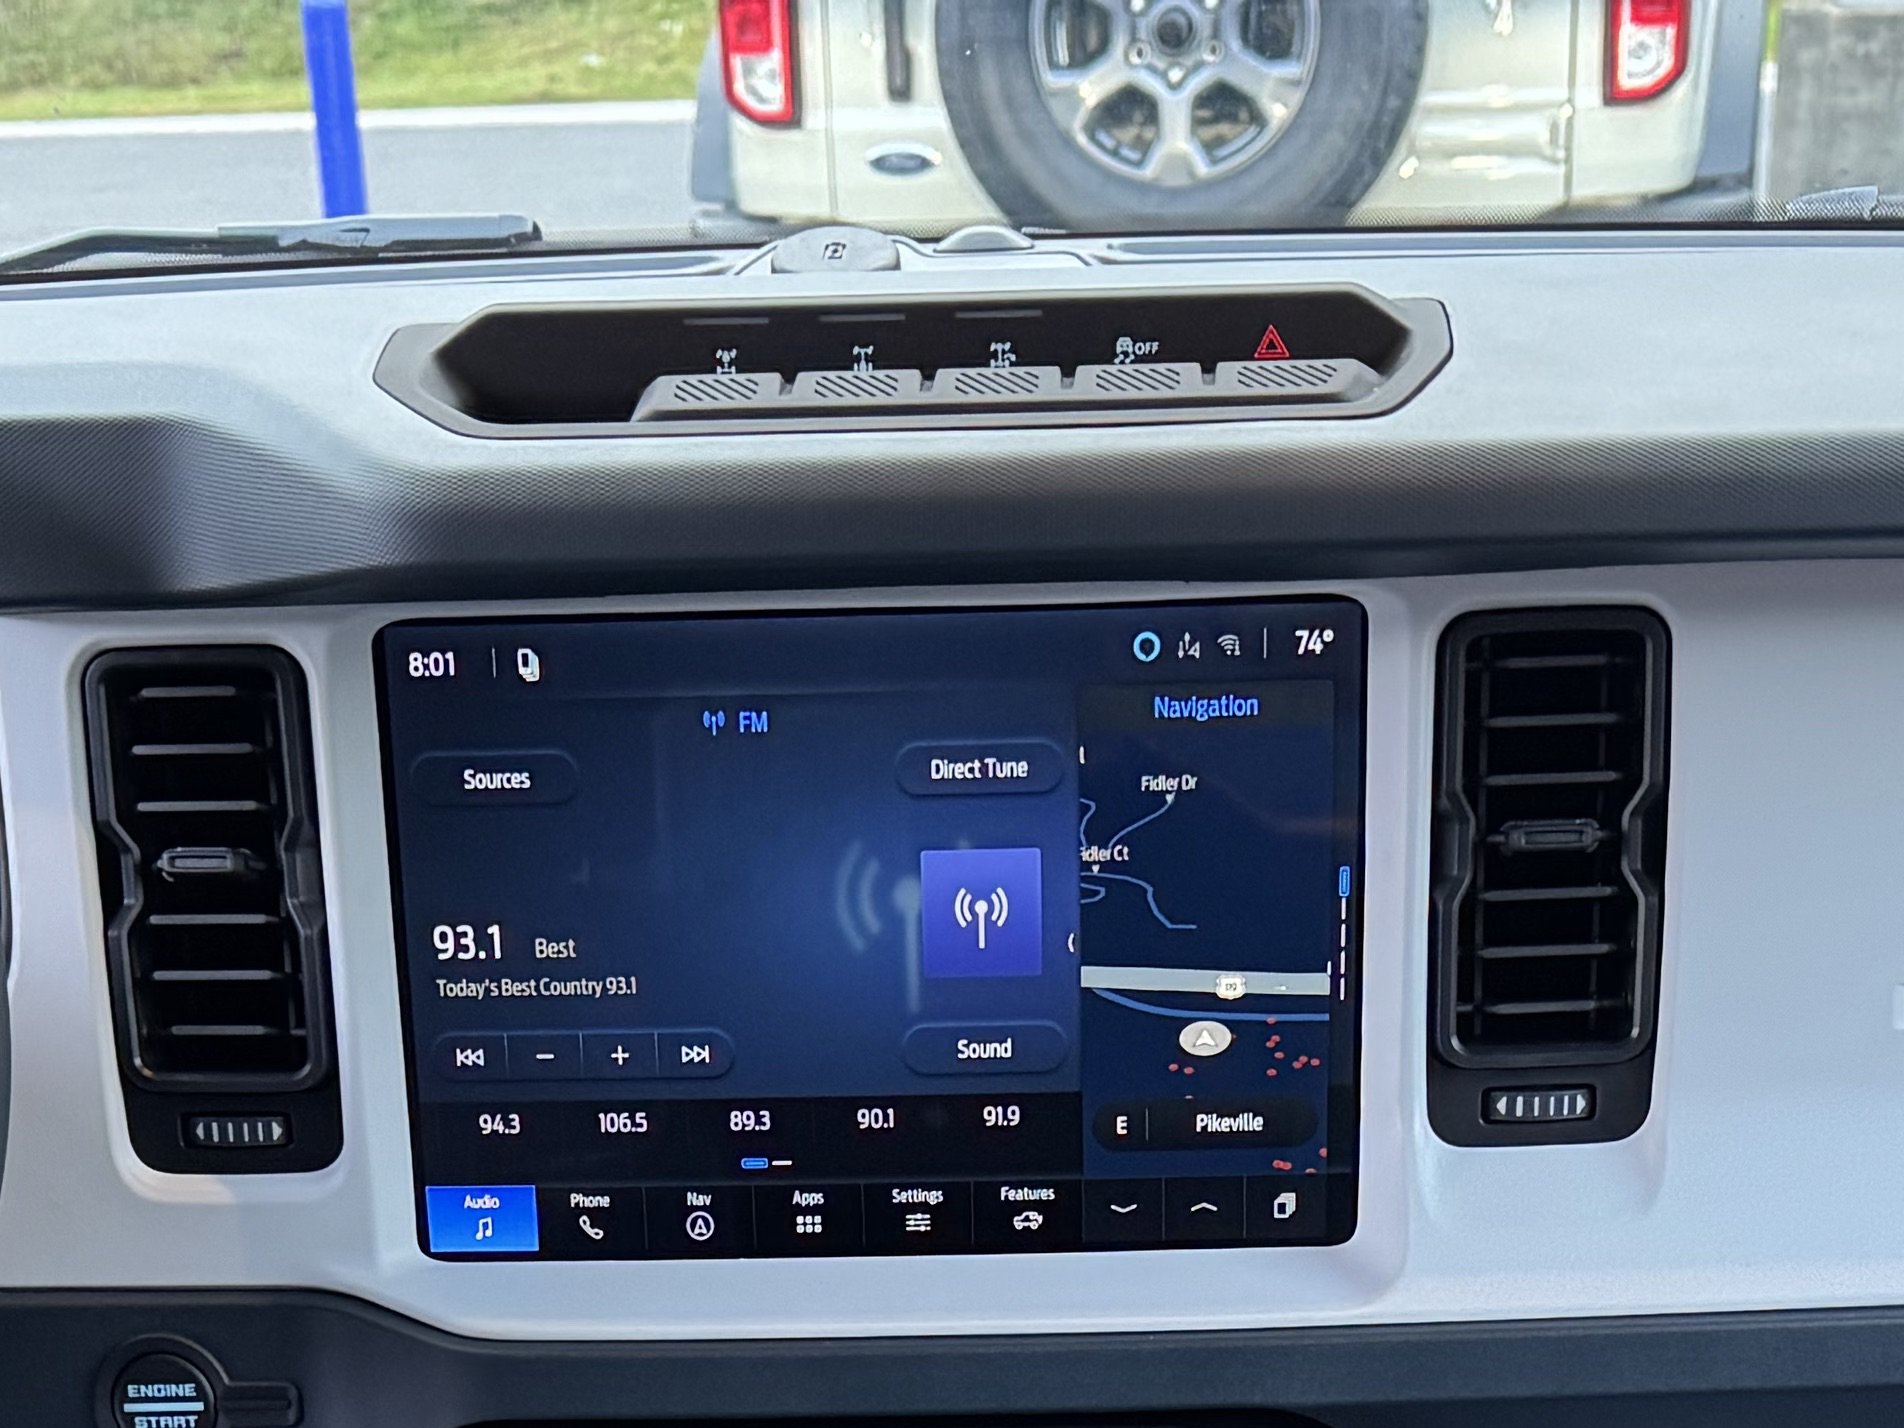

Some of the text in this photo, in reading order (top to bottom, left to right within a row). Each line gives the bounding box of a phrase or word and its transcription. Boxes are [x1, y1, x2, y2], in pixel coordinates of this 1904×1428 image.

[1134, 340, 1159, 356] OFF
[1295, 628, 1335, 655] 74°
[408, 651, 456, 678] 8:01
[1154, 695, 1259, 722] Navigation
[739, 711, 768, 733] FM
[463, 768, 531, 789] Sources
[930, 757, 1029, 780] Direct Tune
[1141, 774, 1197, 792] Fidler Dr
[1080, 844, 1129, 862] idler Ct
[433, 925, 577, 960] 93.1 Best
[436, 976, 637, 1000] Today's Best Country 93.1
[957, 1037, 1012, 1059] Sound
[479, 1114, 520, 1134] 94.3
[598, 1112, 648, 1133] 106.5
[729, 1110, 771, 1131] 89.3
[857, 1108, 895, 1129] 90.1
[983, 1105, 1020, 1127] 91.9
[1116, 1115, 1128, 1135] E
[1195, 1113, 1264, 1133] Pikeville
[463, 1193, 500, 1209] Audio
[570, 1192, 610, 1208] Phone
[687, 1191, 712, 1206] Nav
[792, 1189, 824, 1207] Apps
[892, 1187, 944, 1205] Settings
[1000, 1185, 1055, 1201] Features
[127, 1383, 196, 1399] ENGINE
